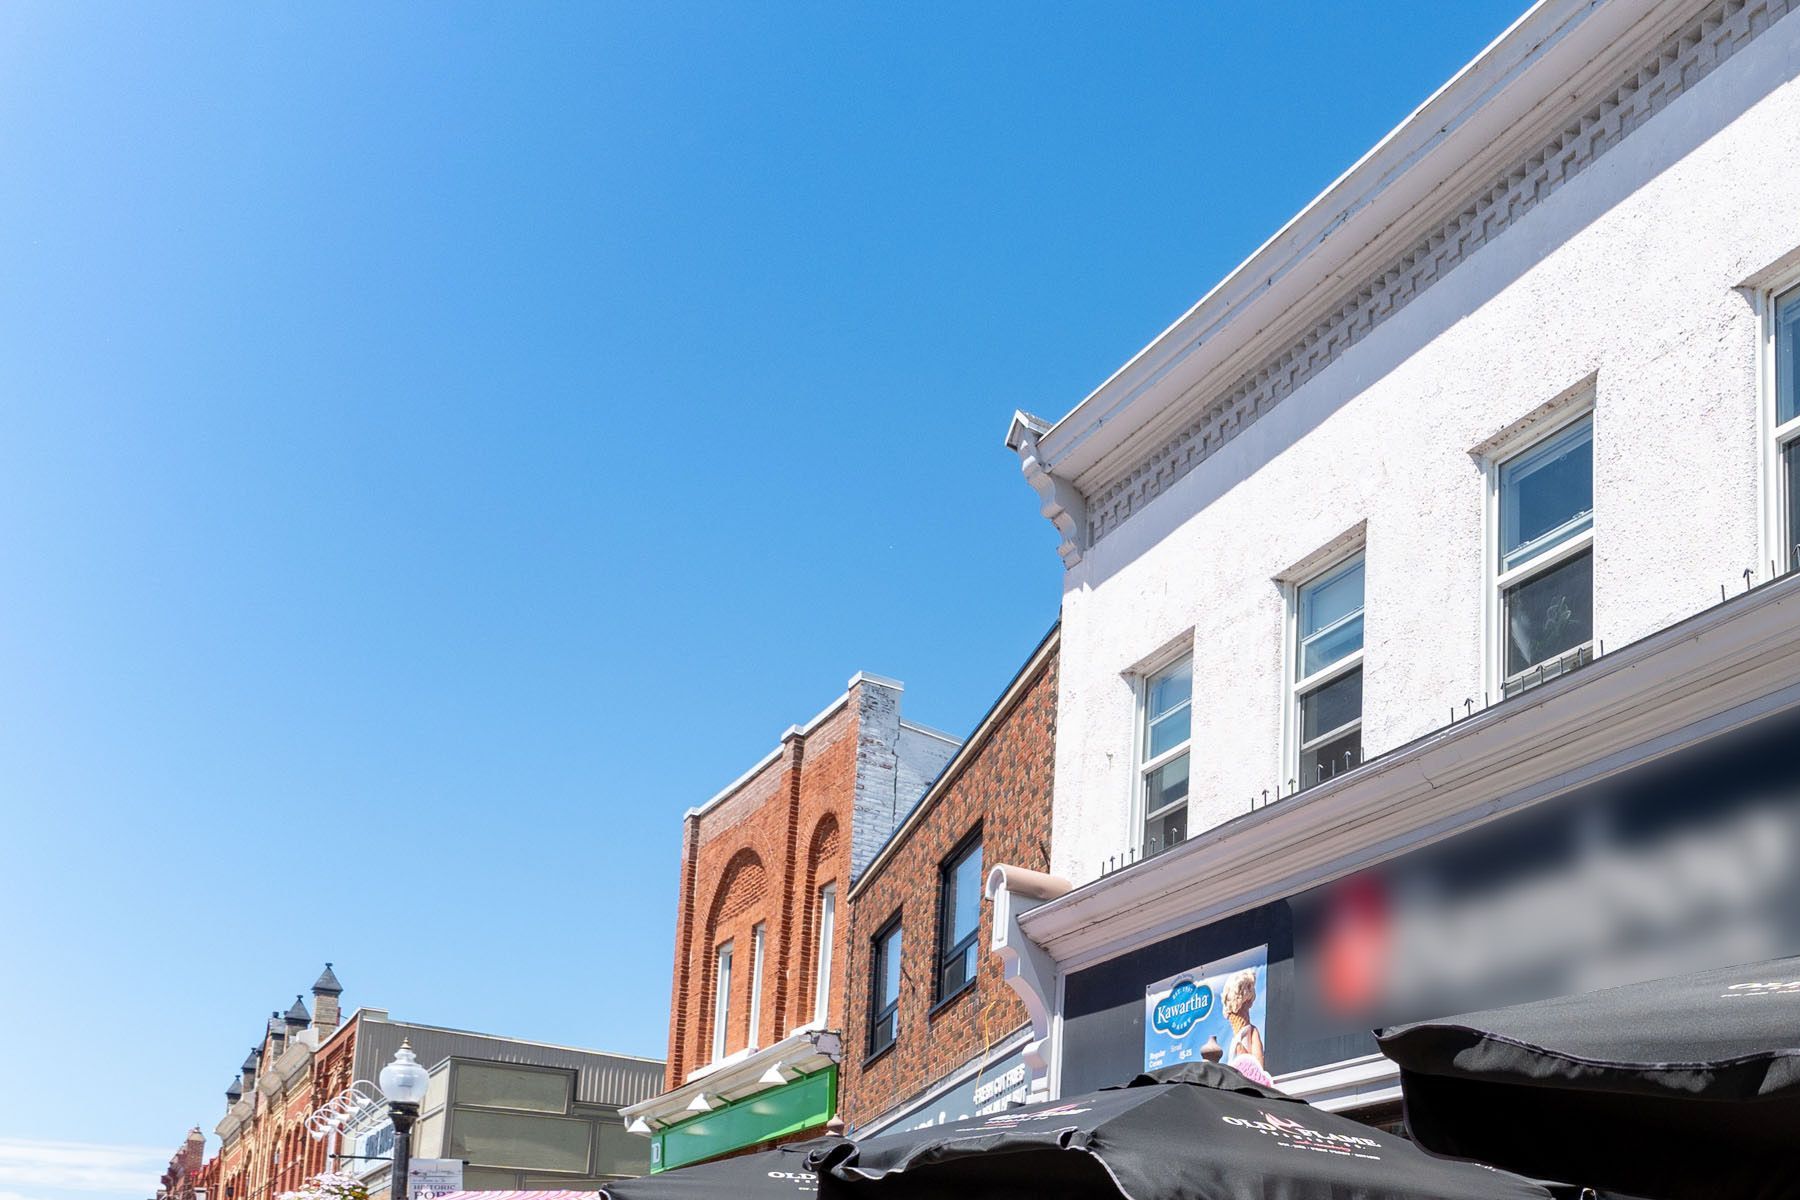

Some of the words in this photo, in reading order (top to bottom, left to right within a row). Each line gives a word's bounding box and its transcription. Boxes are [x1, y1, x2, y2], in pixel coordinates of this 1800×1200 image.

[1157, 993, 1208, 1024] Kawartha
[1222, 1116, 1277, 1132] OLD
[1294, 1127, 1382, 1148] FLAME
[768, 1171, 817, 1180] OLD
